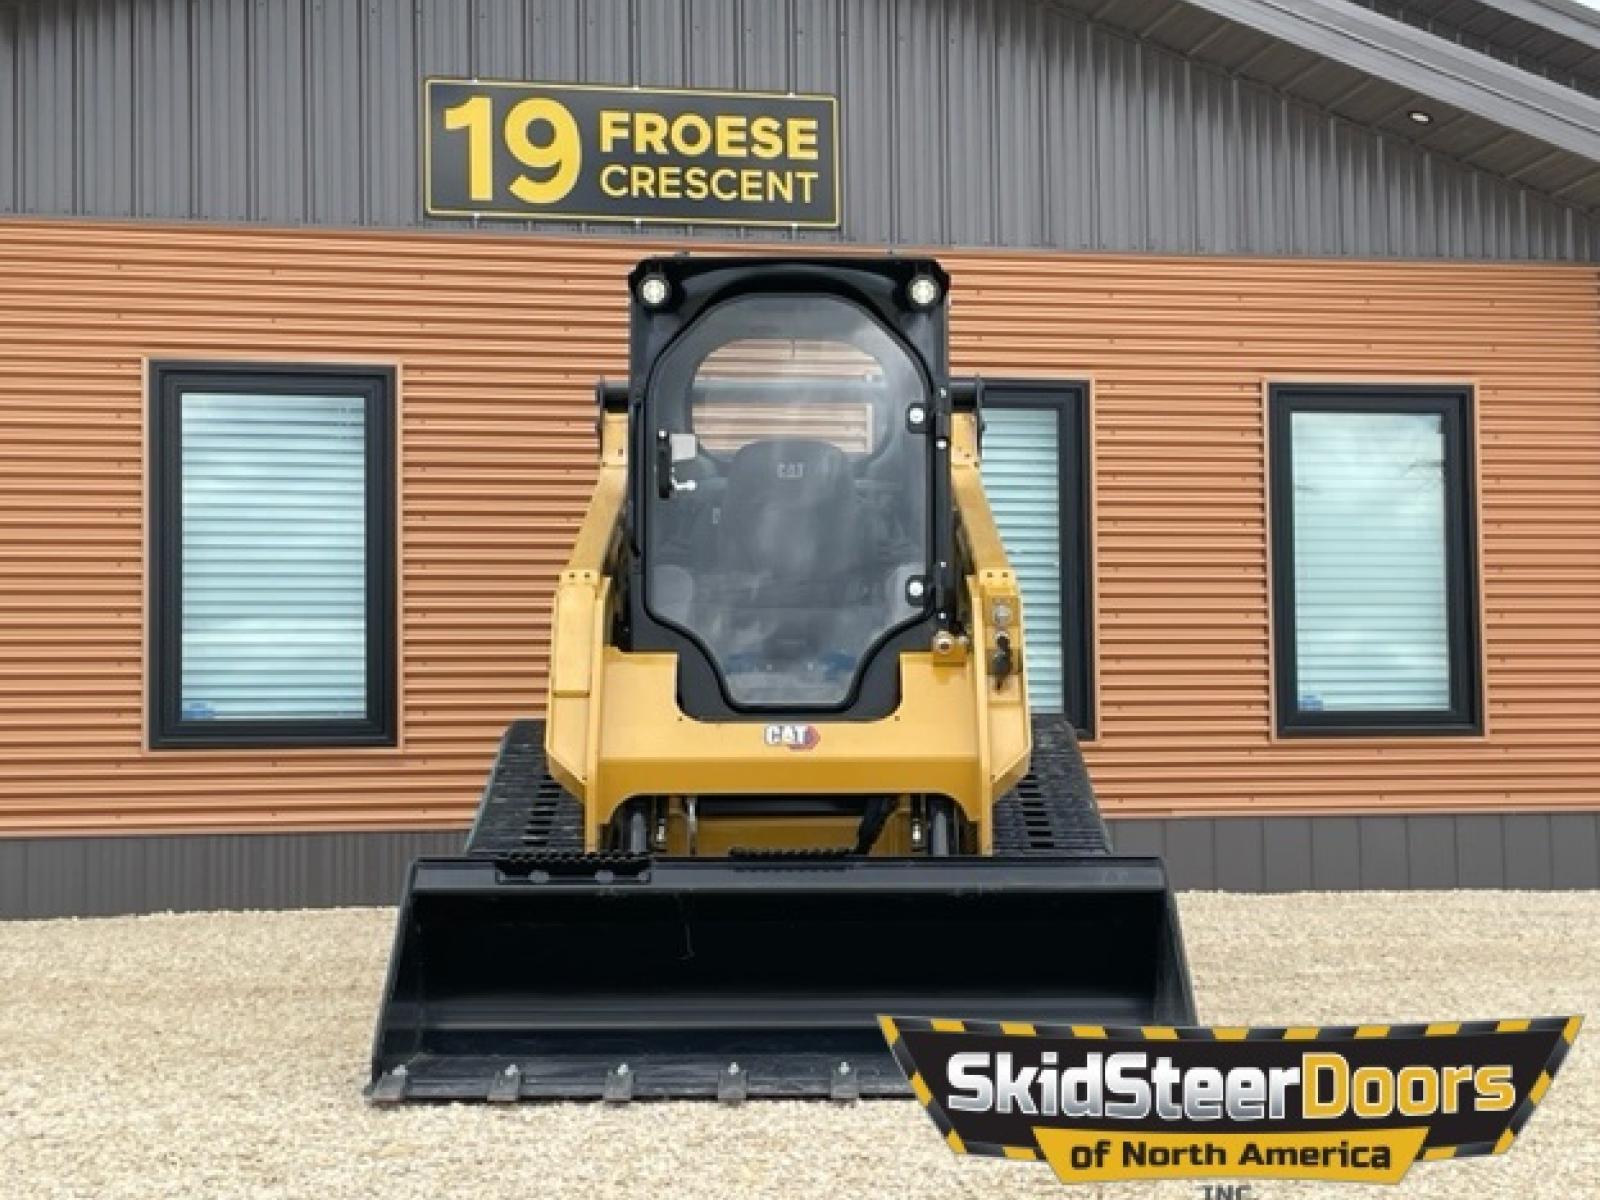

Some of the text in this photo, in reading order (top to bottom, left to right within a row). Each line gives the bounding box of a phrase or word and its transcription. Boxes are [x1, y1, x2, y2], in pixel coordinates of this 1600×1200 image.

[443, 96, 582, 204] 19
[600, 110, 819, 160] FROESE
[600, 164, 820, 204] CRESCENT
[764, 724, 809, 745] CAT
